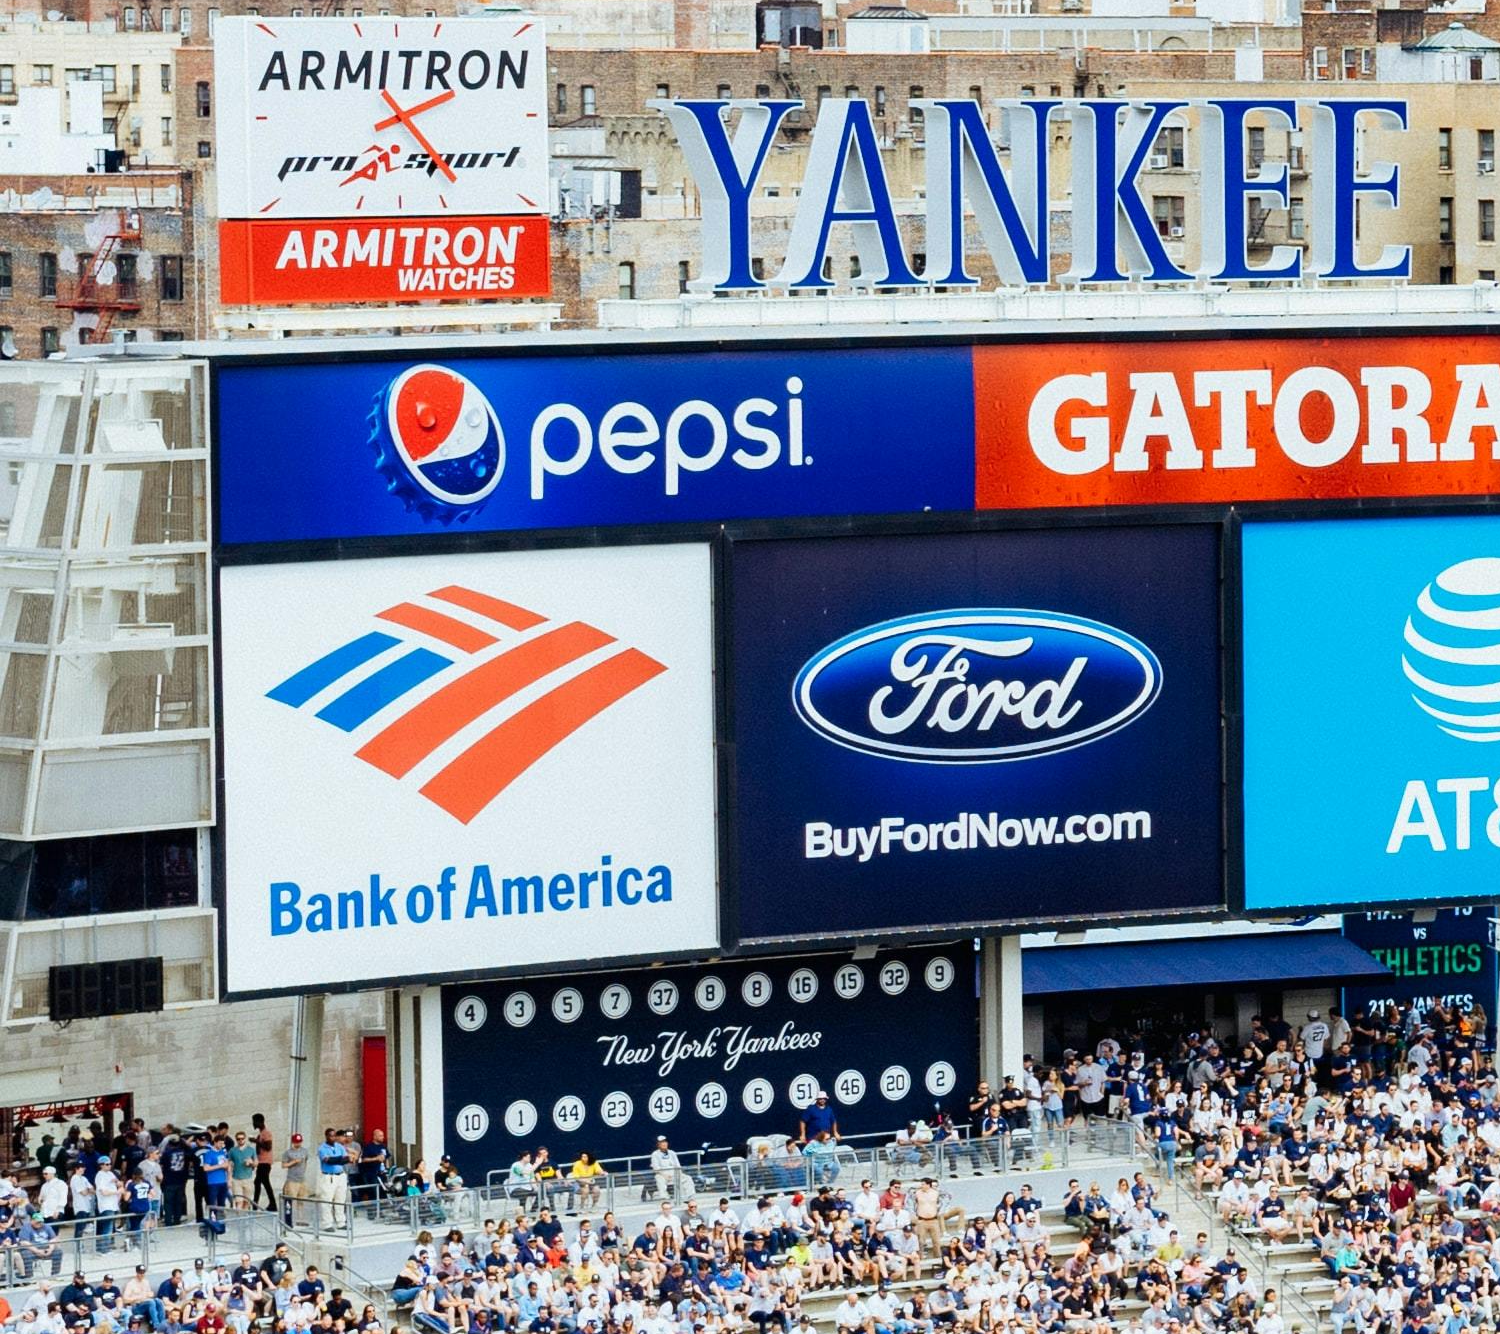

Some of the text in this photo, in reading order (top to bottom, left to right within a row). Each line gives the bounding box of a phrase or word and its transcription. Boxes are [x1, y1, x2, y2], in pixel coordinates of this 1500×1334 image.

[259, 50, 528, 92] ARMITRON
[684, 100, 1412, 290] YANKEE
[276, 227, 517, 269] ARMITRON
[398, 267, 515, 292] WATCHES
[531, 377, 812, 499] pepsi
[868, 635, 1085, 734] Ford
[805, 811, 1151, 861] BuyFordNow.com
[269, 855, 673, 937] Bank of America
[598, 1021, 821, 1076] New York Yankees
